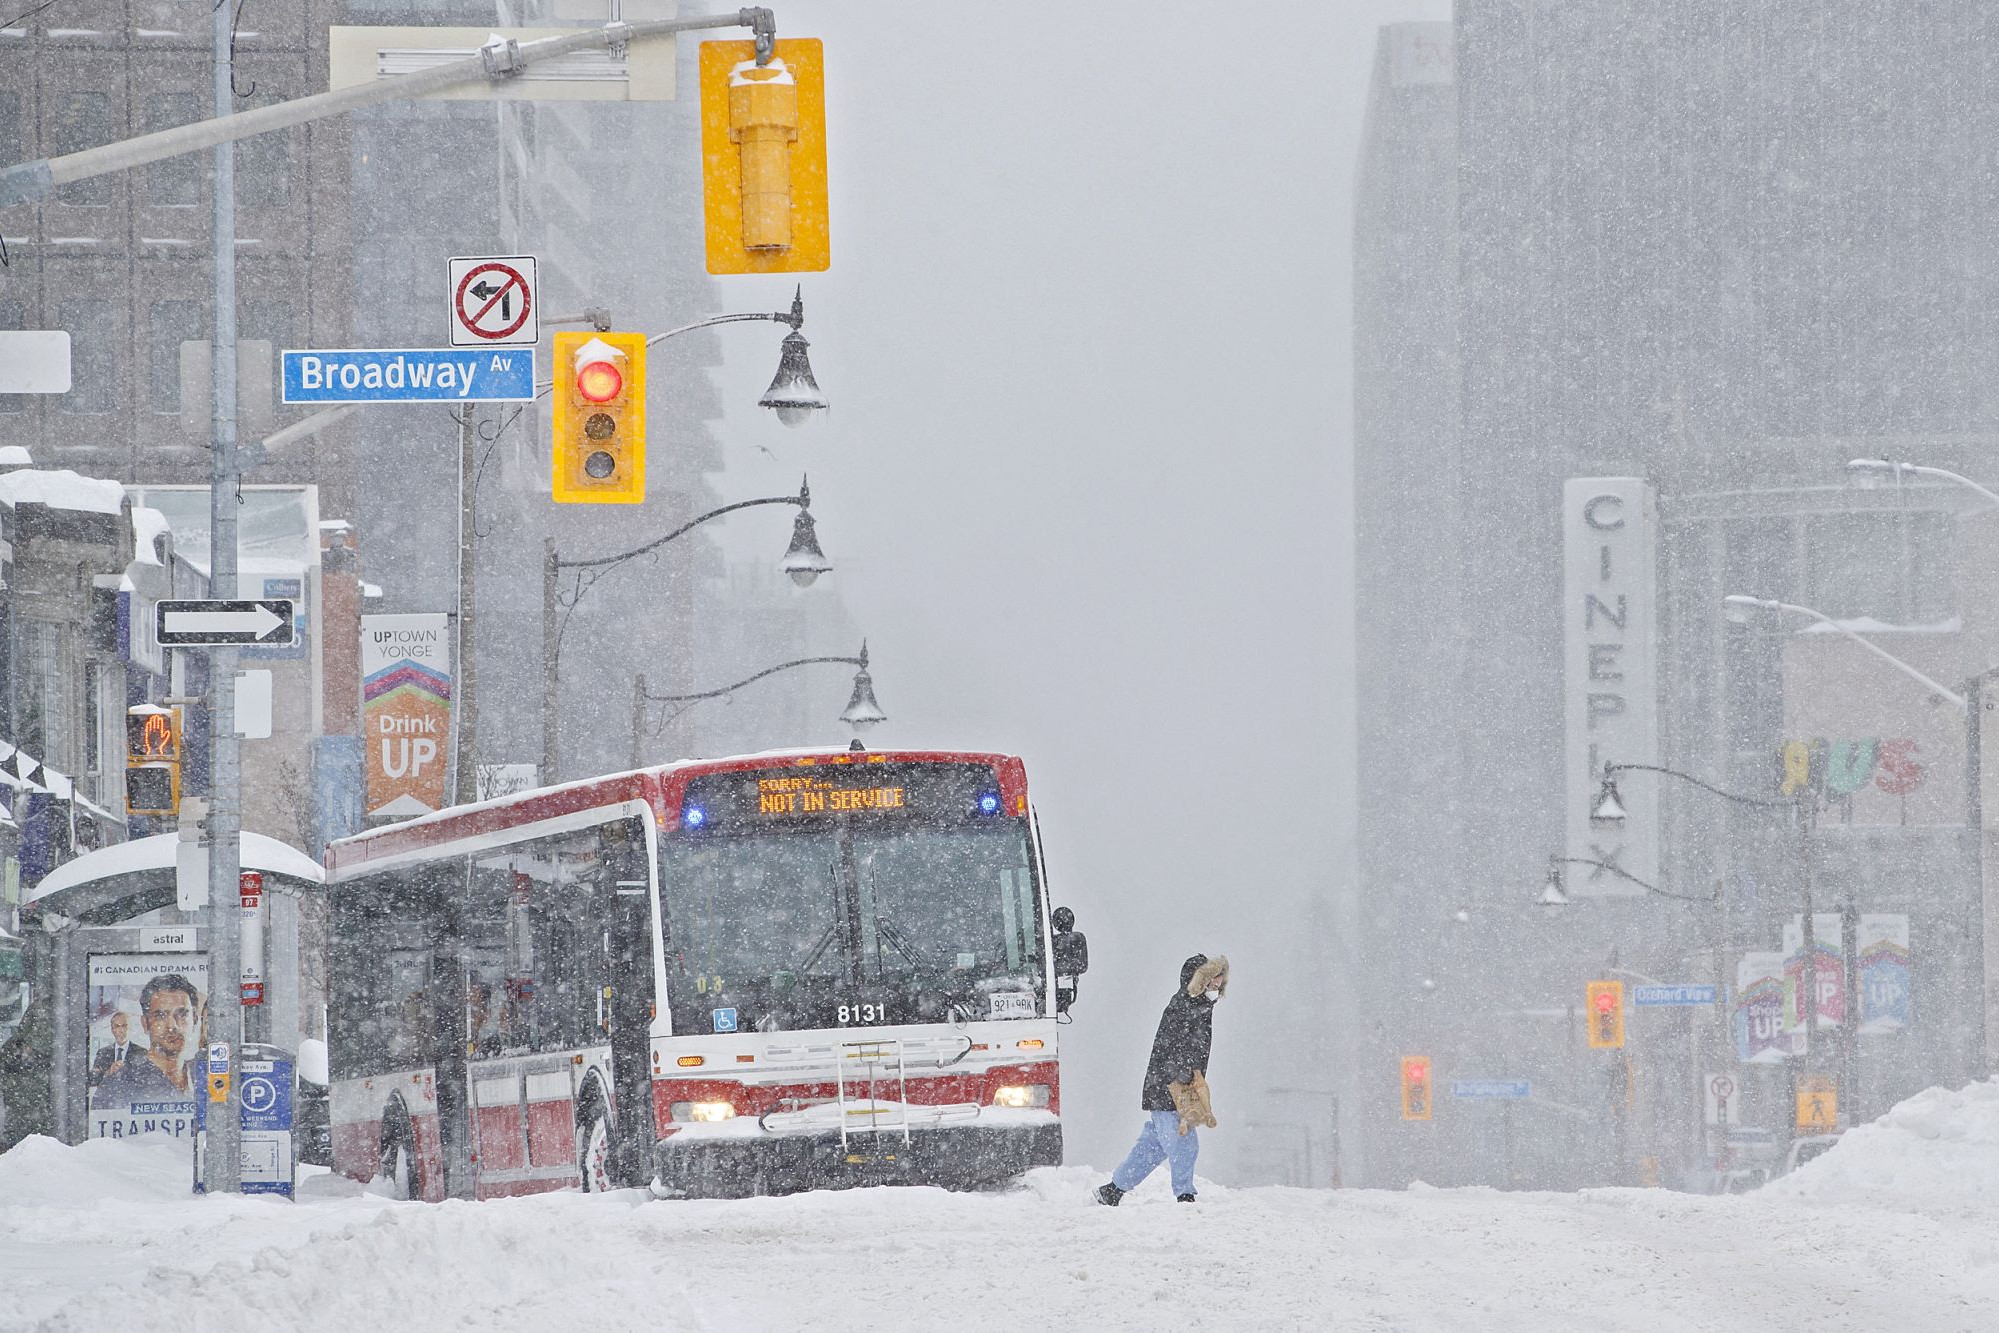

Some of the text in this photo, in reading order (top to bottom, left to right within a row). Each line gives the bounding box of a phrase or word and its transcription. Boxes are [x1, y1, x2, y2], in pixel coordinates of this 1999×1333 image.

[302, 355, 512, 397] Broadway Av
[374, 630, 437, 643] UPTOWN
[380, 645, 432, 658] YONGE
[380, 715, 436, 733] Drink
[382, 738, 437, 778] UP
[760, 787, 904, 813] NOT IN SERVICE
[105, 966, 158, 974] CANADIAN
[837, 1004, 885, 1022] 8131
[135, 1104, 159, 1113] NEW
